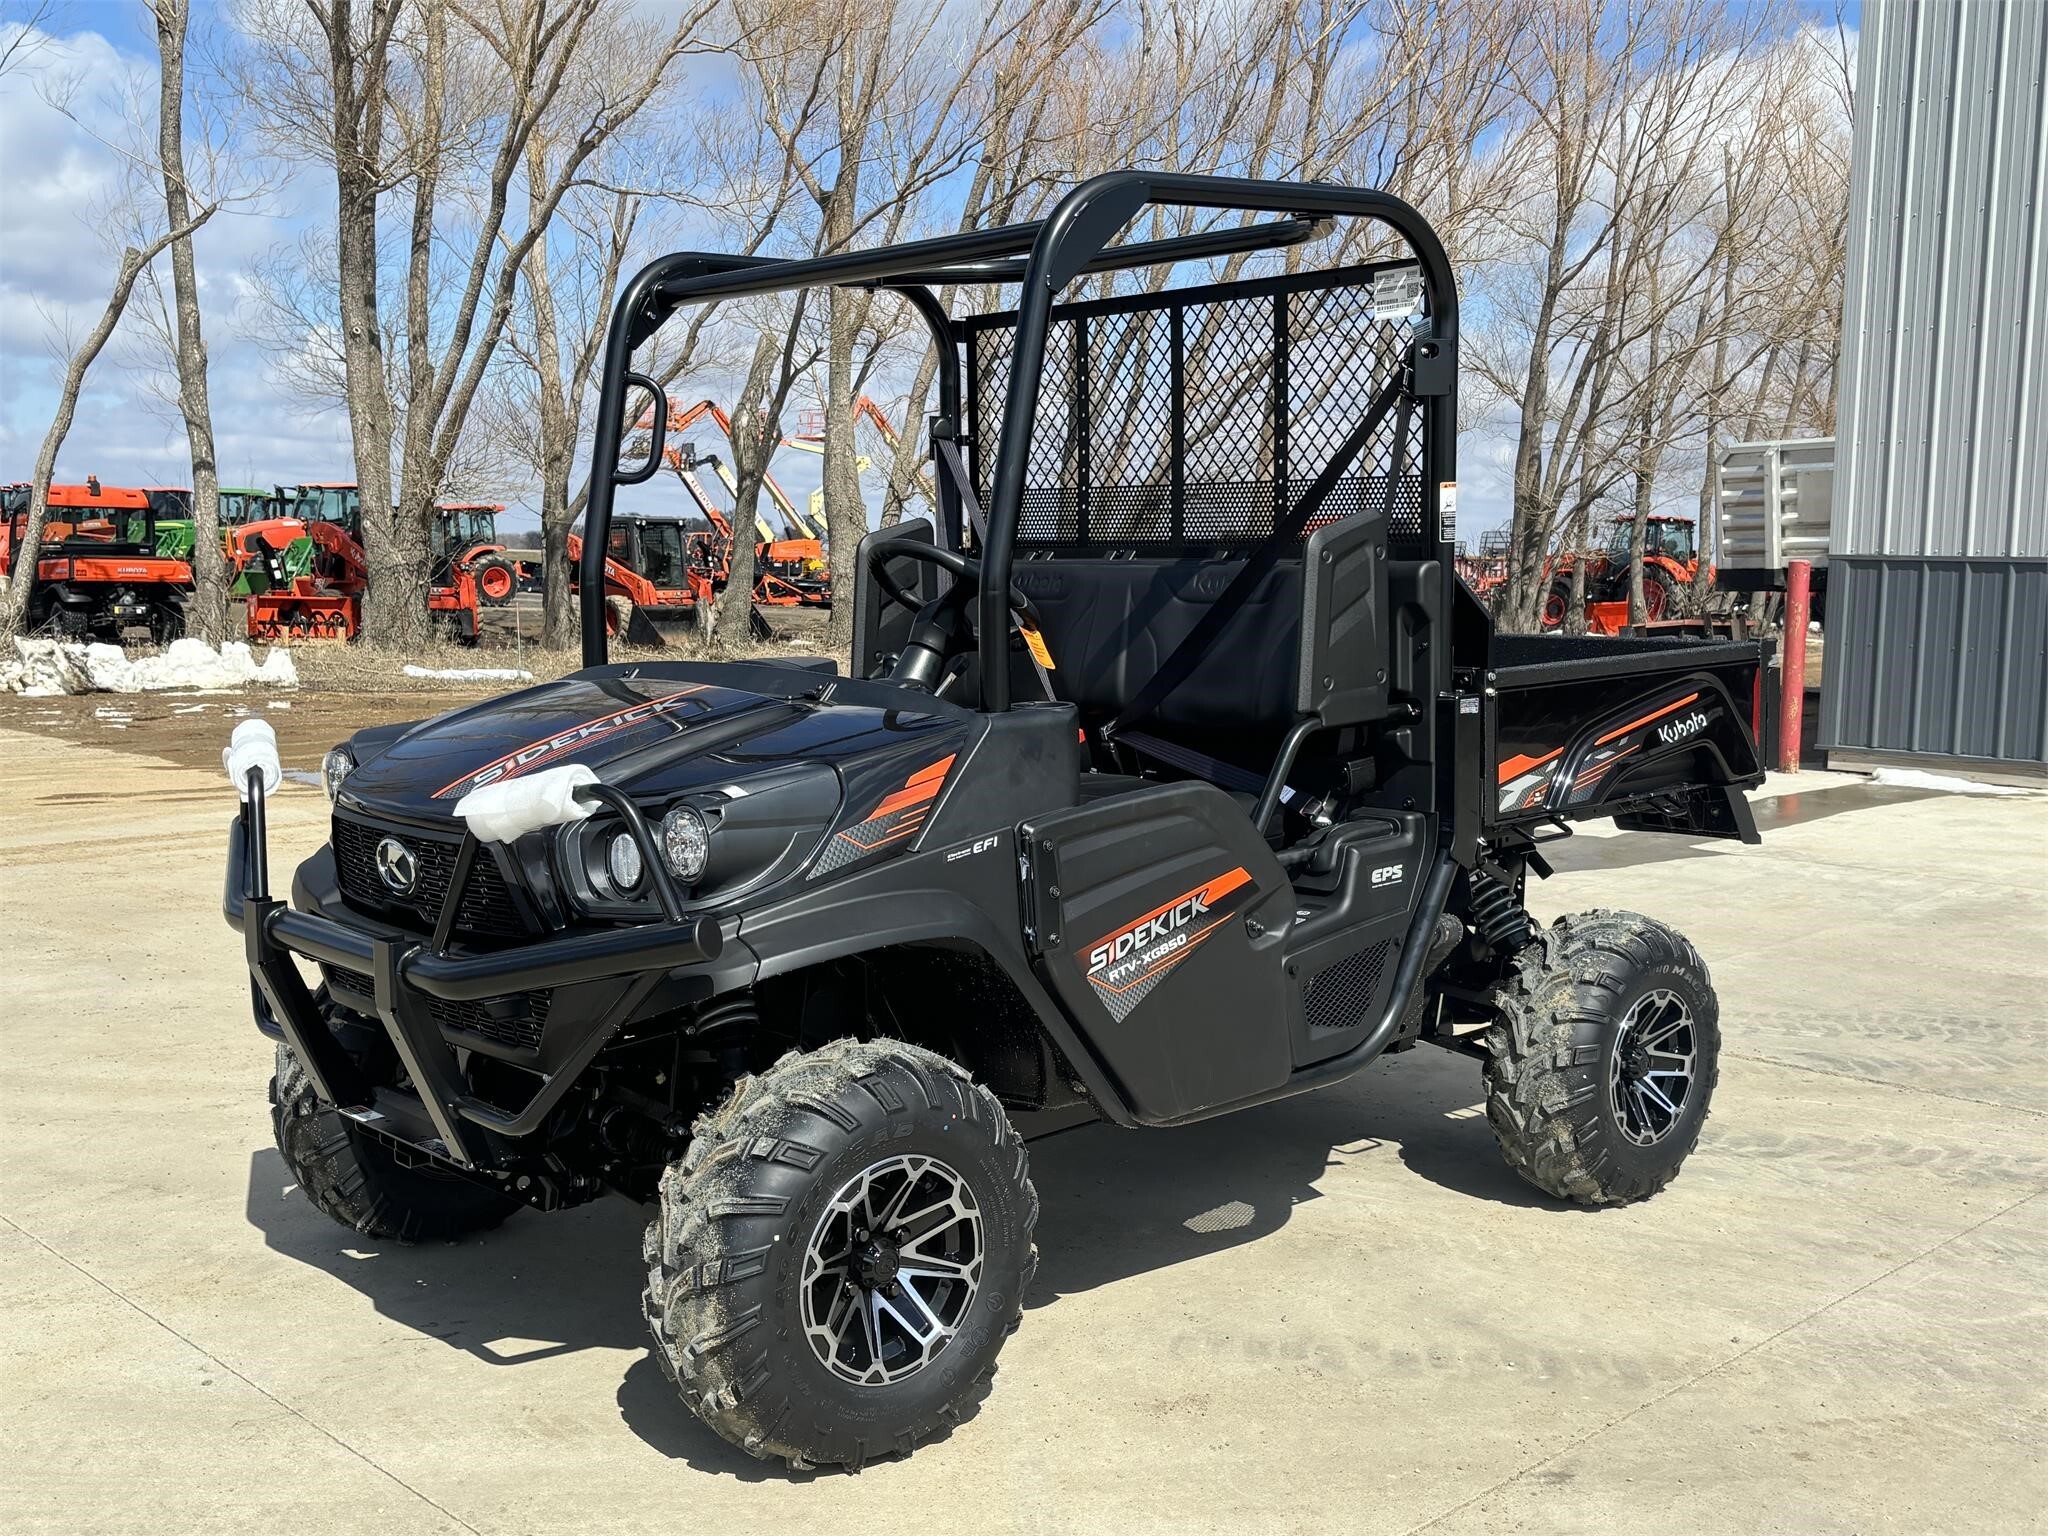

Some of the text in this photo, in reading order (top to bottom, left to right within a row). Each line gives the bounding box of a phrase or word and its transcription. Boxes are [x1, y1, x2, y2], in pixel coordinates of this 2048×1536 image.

[470, 698, 682, 791] SIDEKICK
[1657, 712, 1707, 744] Kubota
[973, 836, 998, 855] EFI
[1371, 864, 1403, 884] EPS
[1087, 888, 1210, 977] SIDEKICK
[1108, 933, 1188, 983] RTV-XG850
